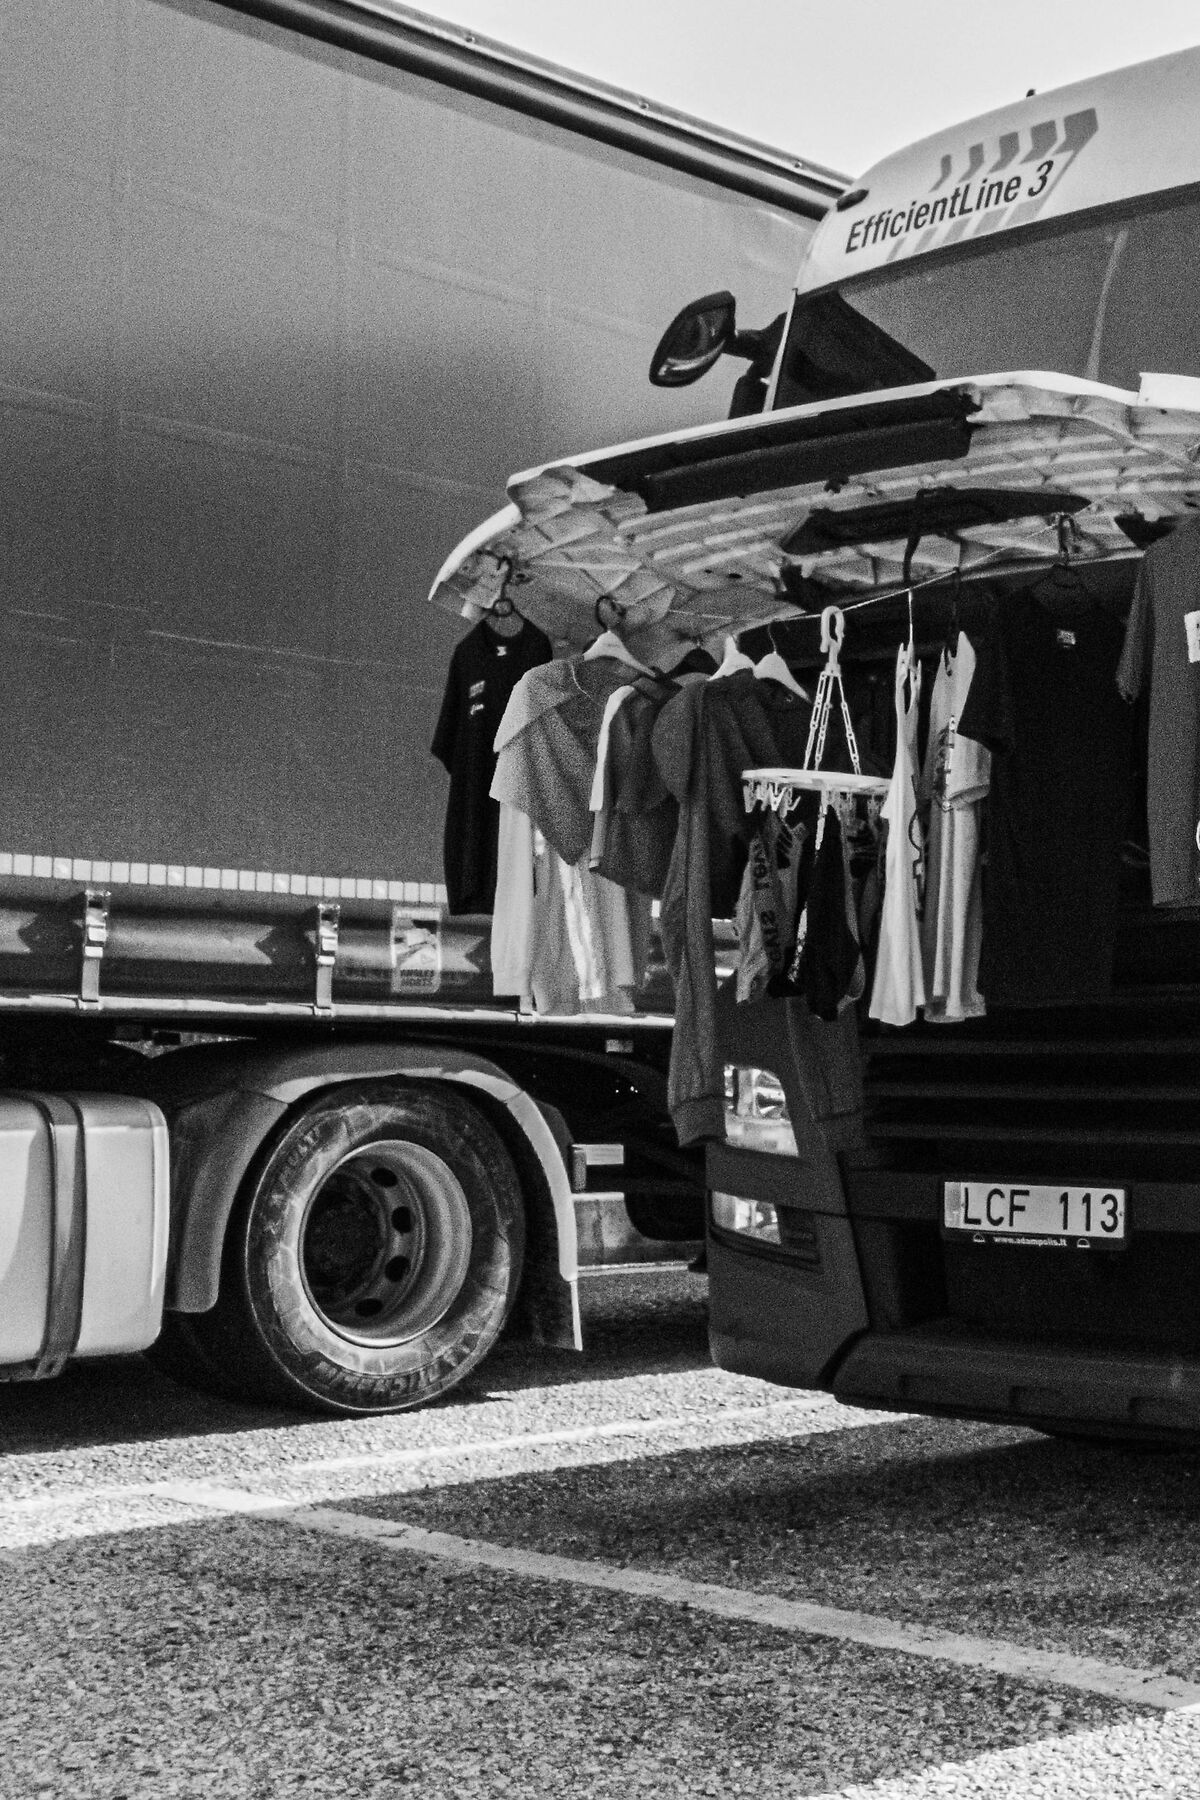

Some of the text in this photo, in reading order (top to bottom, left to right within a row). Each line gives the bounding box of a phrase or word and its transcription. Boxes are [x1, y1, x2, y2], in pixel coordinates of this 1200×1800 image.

[845, 159, 1054, 254] EfficientLine 3
[964, 1187, 1030, 1227] LCF
[1059, 1191, 1119, 1233] 113
